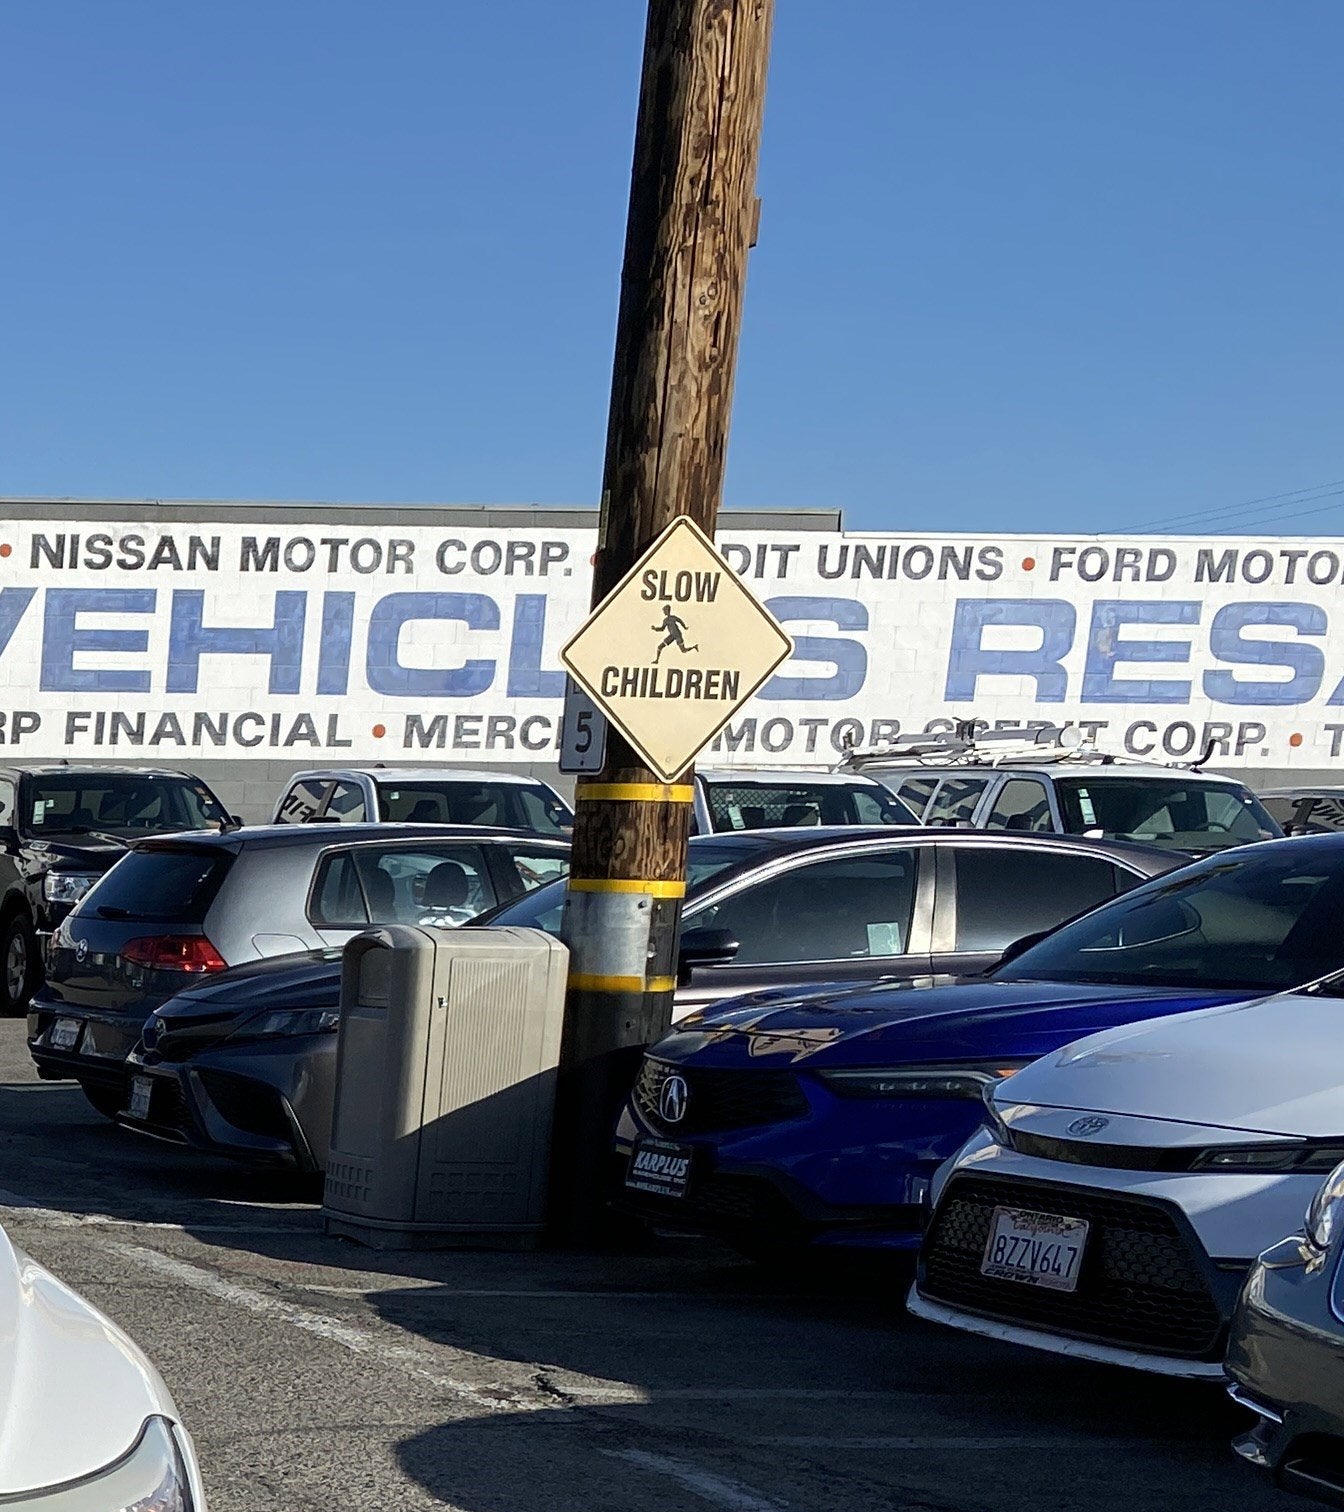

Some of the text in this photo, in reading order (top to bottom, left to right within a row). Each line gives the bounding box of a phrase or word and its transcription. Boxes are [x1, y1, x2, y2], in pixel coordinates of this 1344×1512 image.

[29, 533, 221, 572] NISSAN
[239, 536, 414, 574] MOTOR
[436, 539, 572, 577] CORP.
[720, 544, 800, 578] DIT
[818, 545, 1004, 582] UNIONS
[1049, 547, 1177, 583] FORD
[1194, 548, 1344, 585] MOTO
[640, 569, 721, 602] SLOW
[600, 666, 741, 700] CHILDREN
[64, 711, 353, 748] FINANCIAL
[403, 714, 563, 751] MERC
[1123, 720, 1269, 757] CORP.
[574, 711, 593, 753] 5
[634, 1150, 689, 1177] KARPLUS
[993, 1234, 1078, 1279] 8ZZV647
